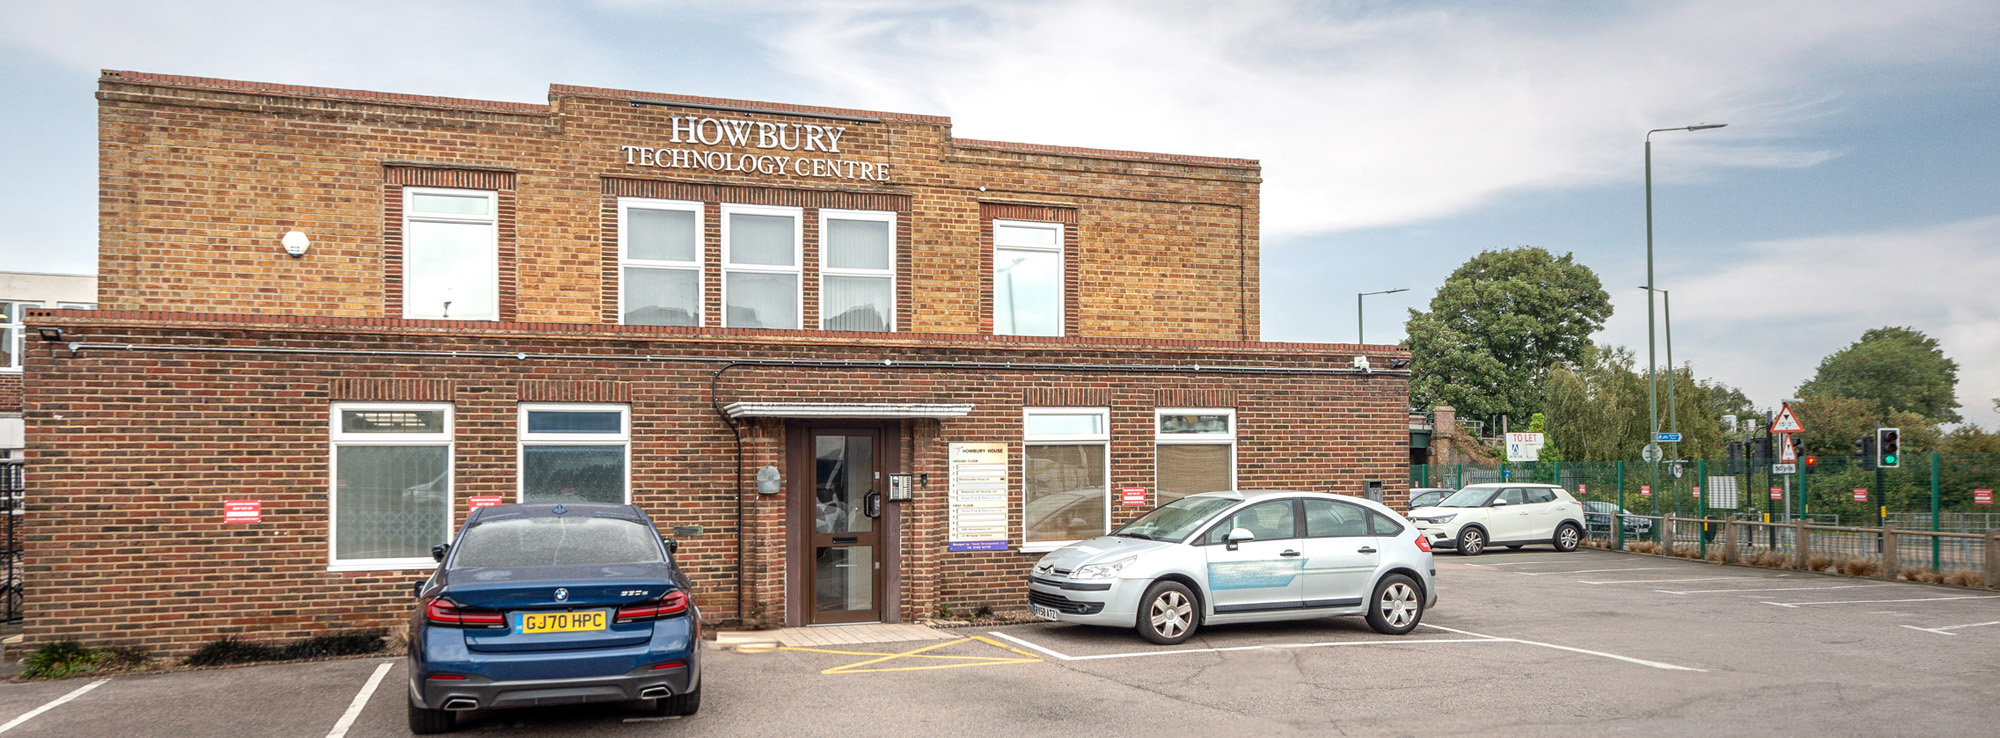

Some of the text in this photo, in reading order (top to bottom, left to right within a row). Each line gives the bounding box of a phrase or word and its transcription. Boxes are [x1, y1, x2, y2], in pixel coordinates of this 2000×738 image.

[669, 116, 846, 152] HOWBURY
[622, 146, 890, 182] TECHNOLOGY CENTRE
[1512, 434, 1536, 442] TO LET
[526, 613, 602, 630] GJ70 HPC
